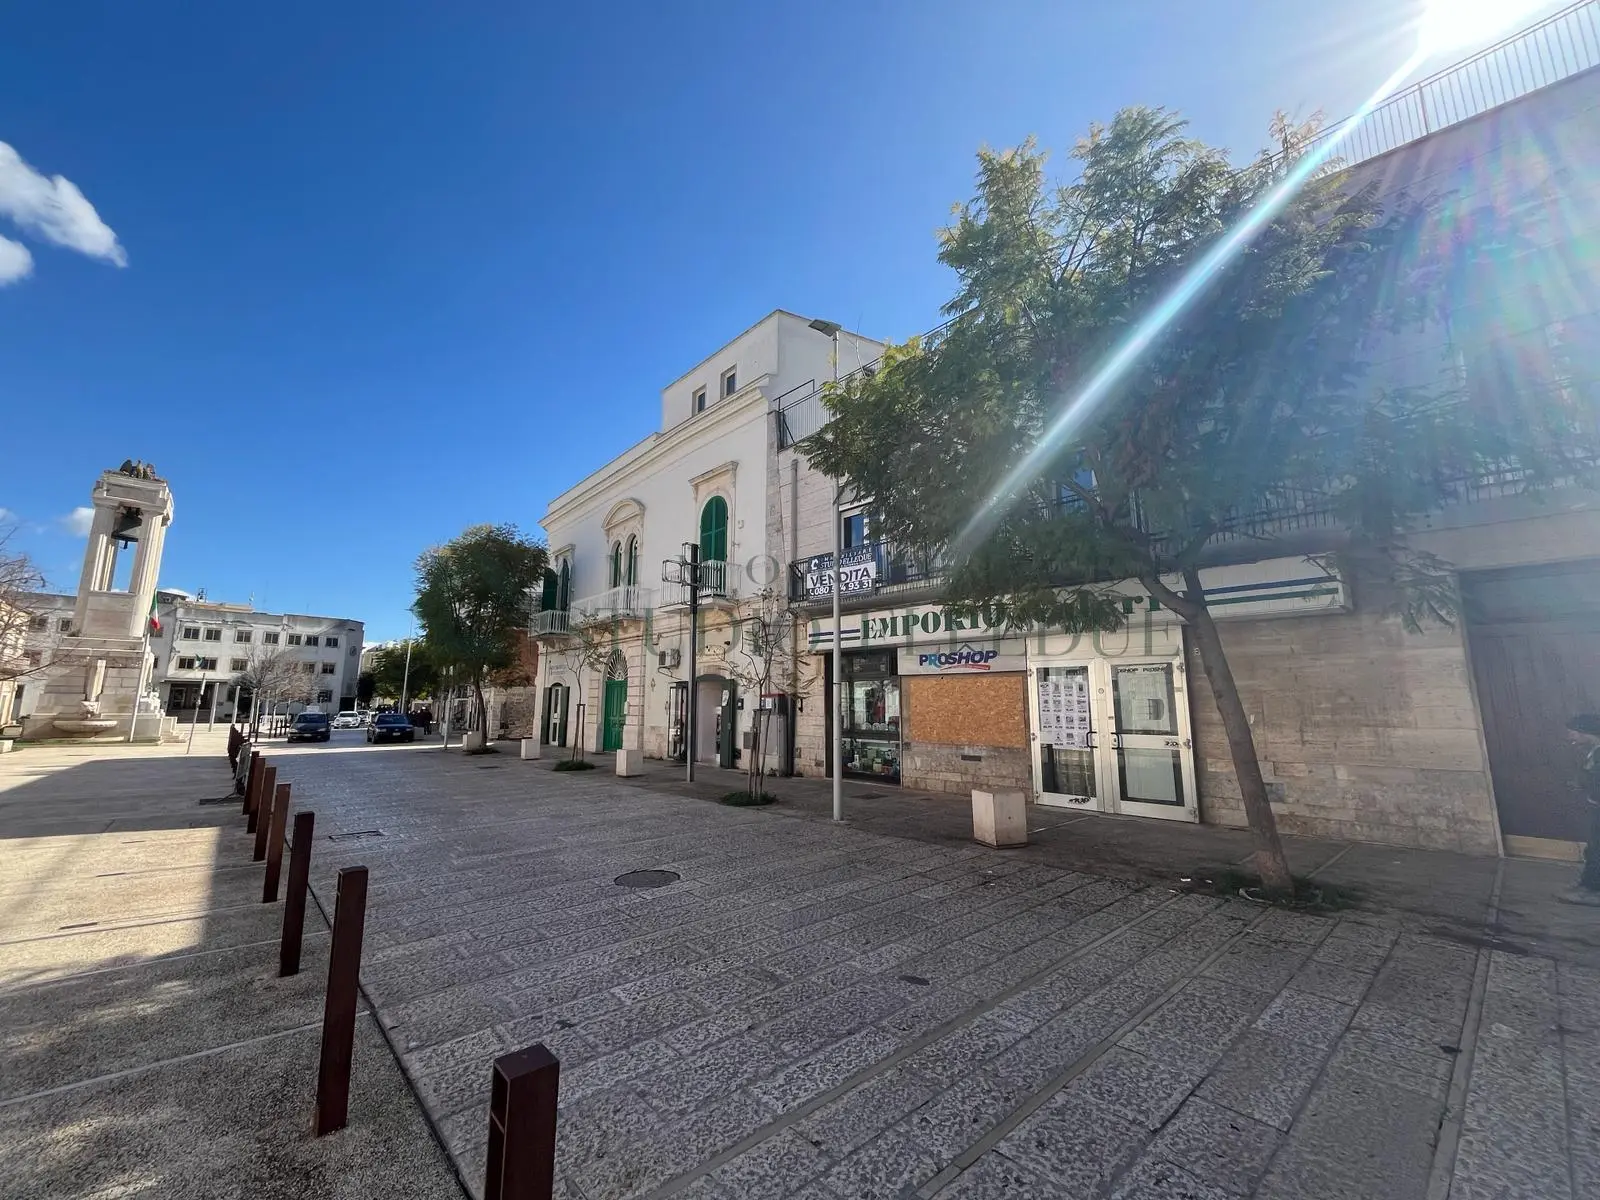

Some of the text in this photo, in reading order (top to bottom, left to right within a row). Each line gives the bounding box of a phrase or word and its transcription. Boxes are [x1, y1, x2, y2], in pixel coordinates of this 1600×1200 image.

[810, 567, 871, 587] VENDITA
[815, 586, 829, 595] 080
[848, 581, 859, 590] 93
[863, 580, 872, 588] 31
[862, 603, 1006, 640] EMPORIO
[919, 650, 998, 668] PROSHOP
